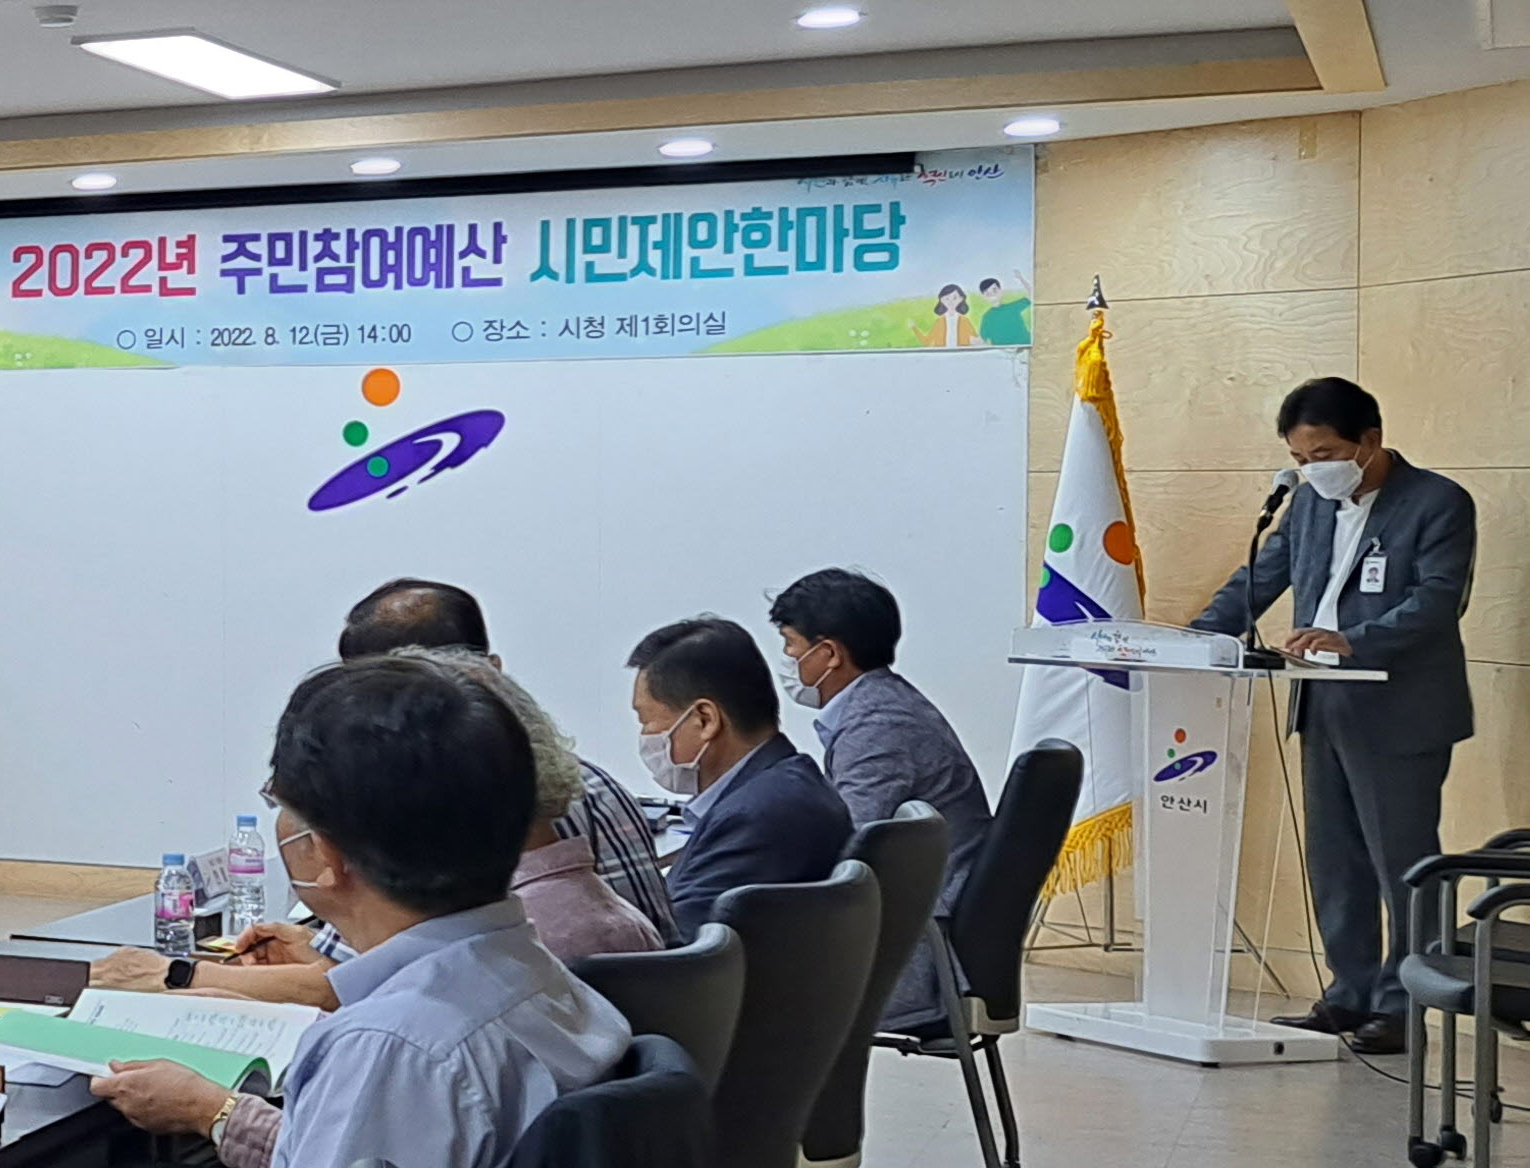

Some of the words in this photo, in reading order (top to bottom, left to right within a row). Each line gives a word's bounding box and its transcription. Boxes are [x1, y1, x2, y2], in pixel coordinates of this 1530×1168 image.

[967, 163, 1005, 181] 안산
[10, 233, 198, 299] 2022년
[218, 221, 510, 296] 주민참여예산
[528, 200, 908, 285] 시민제안한마당
[143, 327, 186, 349] 일시
[356, 322, 413, 345] 14:00
[482, 318, 532, 343] 장소
[557, 316, 606, 342] 시청
[615, 310, 728, 339] 제1회의실
[1160, 794, 1208, 814] 안산시
